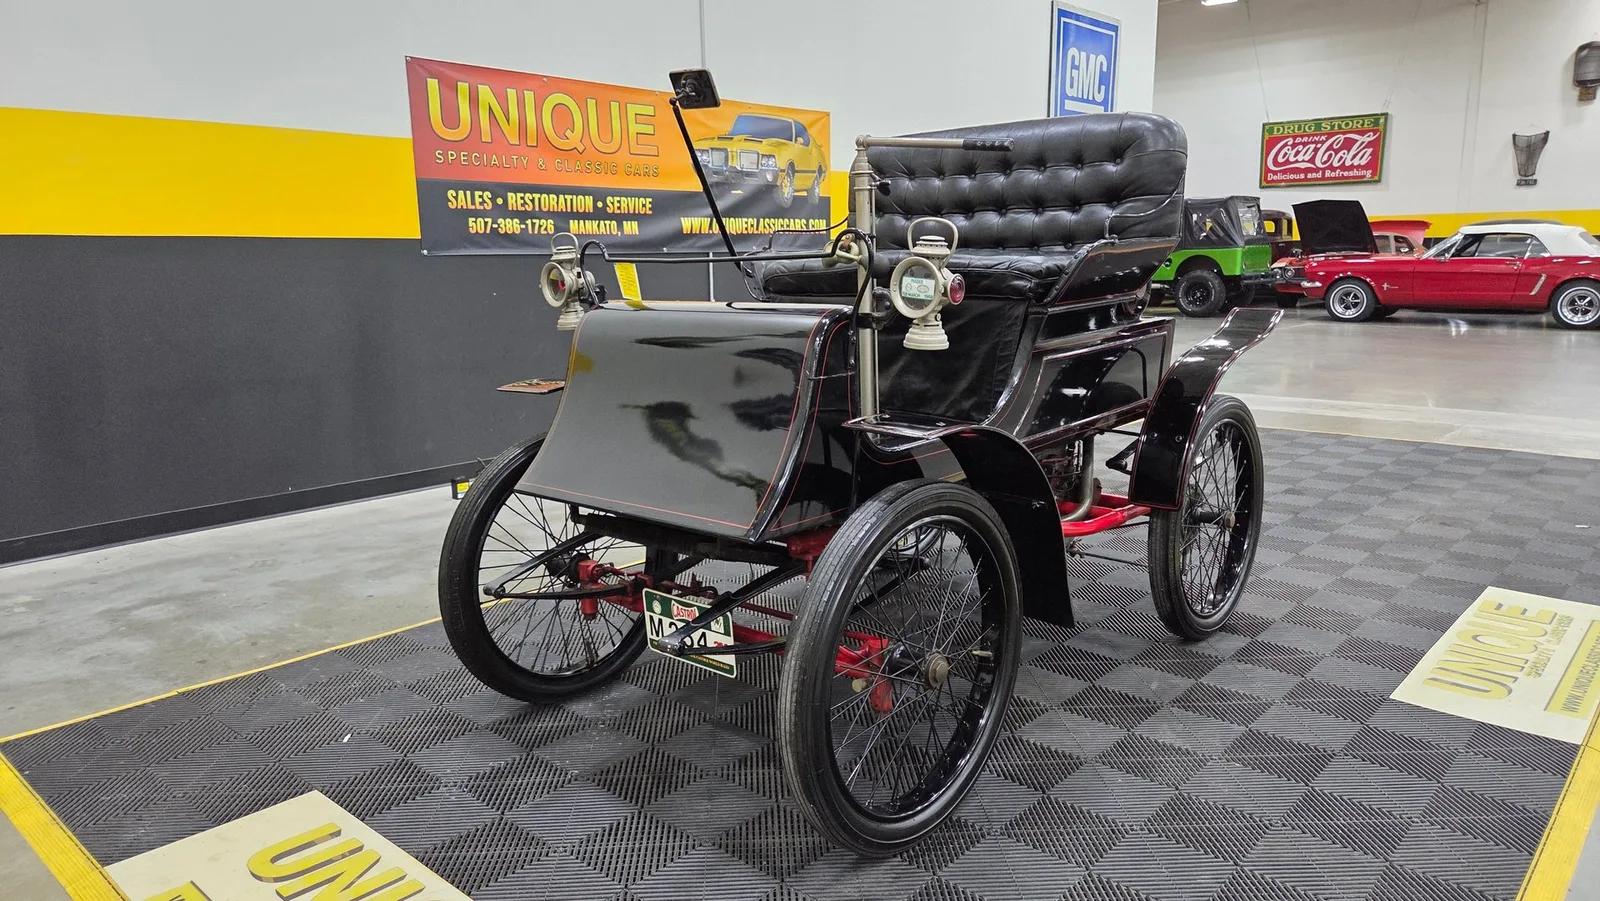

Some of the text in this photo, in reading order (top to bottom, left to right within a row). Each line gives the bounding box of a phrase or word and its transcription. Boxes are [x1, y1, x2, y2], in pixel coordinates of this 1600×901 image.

[1065, 47, 1107, 103] GMC
[426, 77, 660, 157] UNIQUE
[1273, 118, 1374, 135] DRUG STORE
[1266, 131, 1380, 171] Coca-Cola
[1294, 134, 1328, 144] DRINK
[435, 150, 661, 178] SPECIALTY & CLASSIC CARS
[1267, 168, 1373, 181] Delicious and Refreshing
[447, 190, 653, 215] SALES RESTORATION SERVICE
[468, 217, 640, 236] 507-386-1726 MANKATO, MN
[680, 217, 827, 235] WWW.UIQUECLASSICCARS.COM
[1422, 599, 1558, 701] UNIQUE
